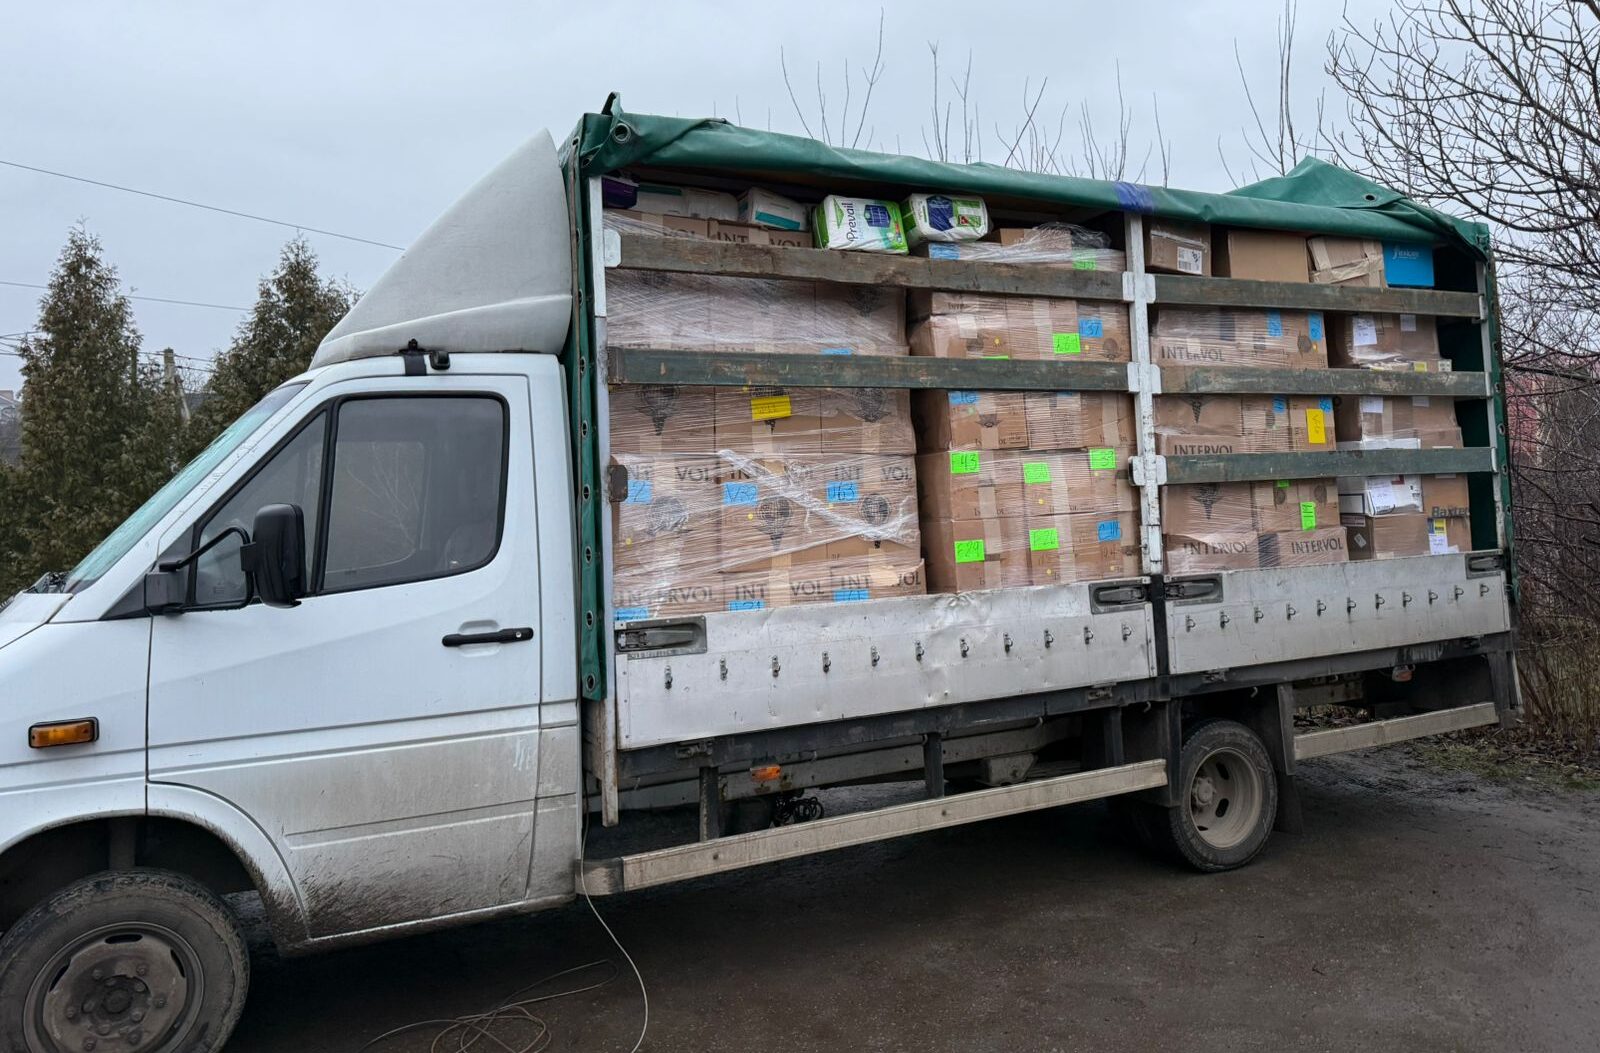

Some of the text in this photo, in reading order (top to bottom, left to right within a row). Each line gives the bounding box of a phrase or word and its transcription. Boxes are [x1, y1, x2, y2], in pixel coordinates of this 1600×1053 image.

[842, 203, 857, 242] Prevail
[1183, 541, 1250, 555] INTERVOL
[1291, 537, 1344, 555] INTERVOL
